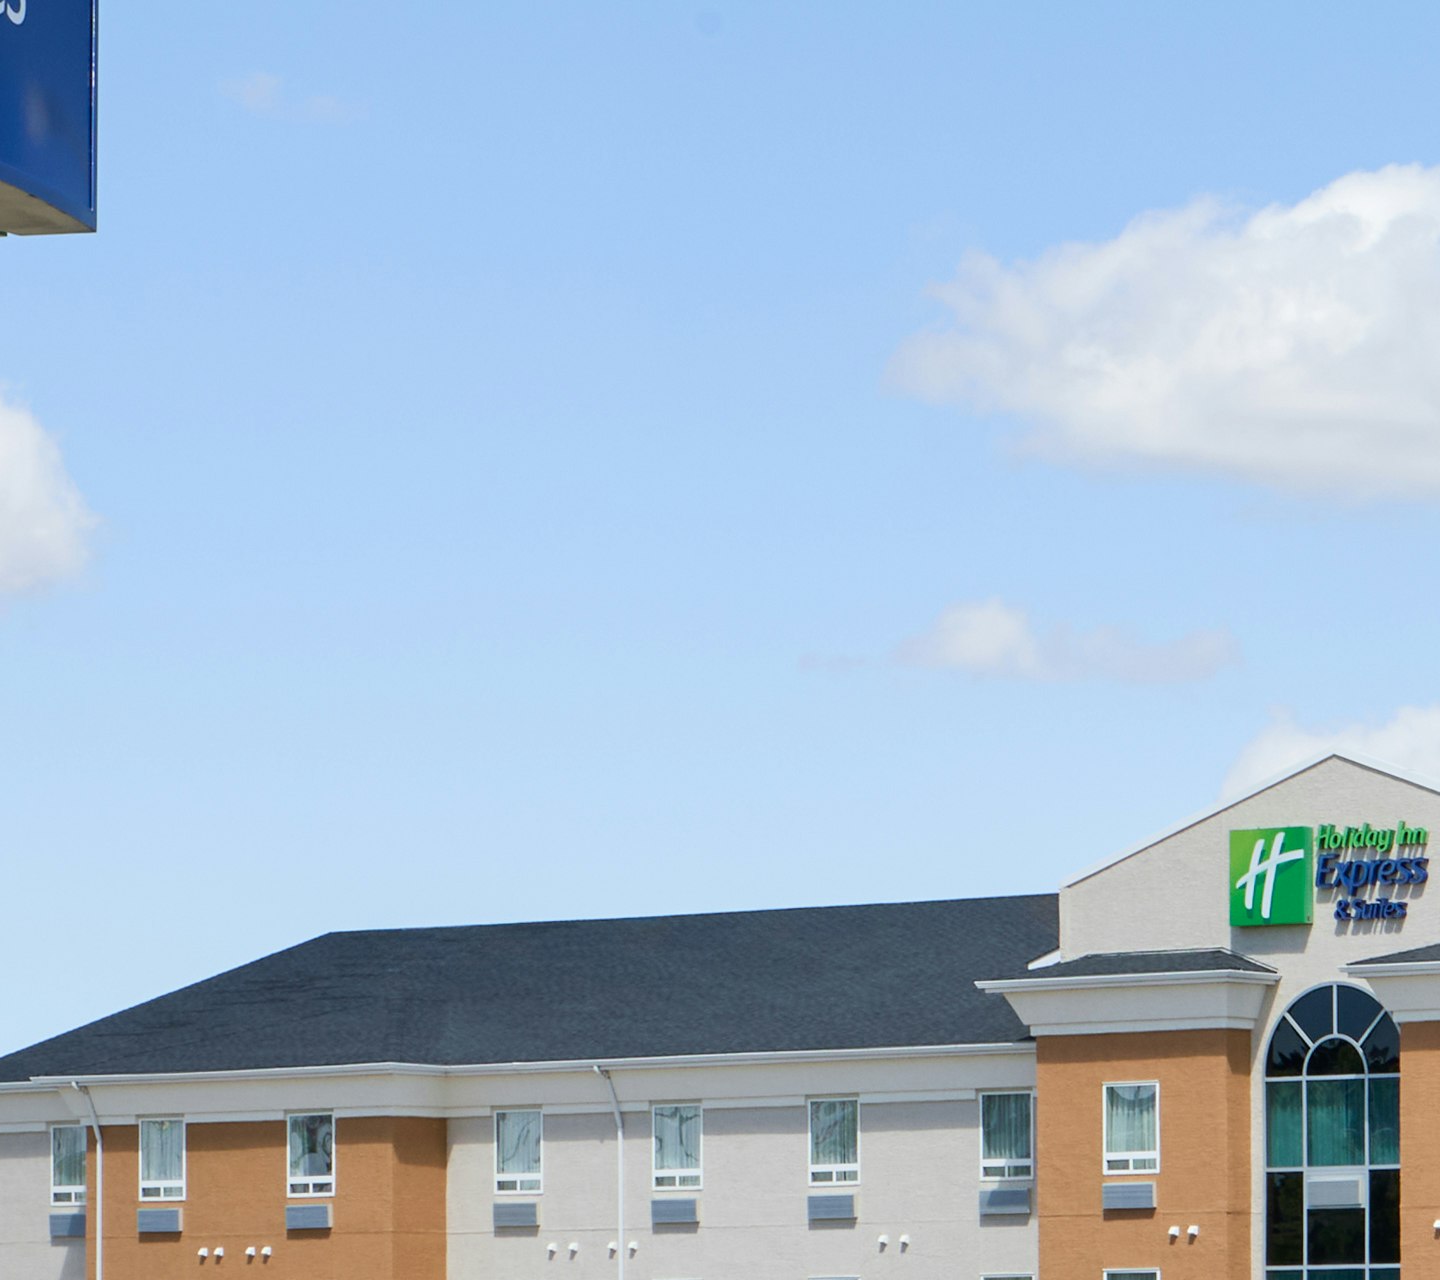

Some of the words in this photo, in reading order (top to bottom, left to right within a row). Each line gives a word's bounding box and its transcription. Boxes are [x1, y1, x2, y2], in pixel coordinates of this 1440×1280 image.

[1316, 822, 1395, 852] Holiday
[1396, 820, 1428, 846] Inn
[1316, 853, 1429, 897] Express
[1334, 900, 1351, 920] &
[1351, 898, 1408, 920] Suites
